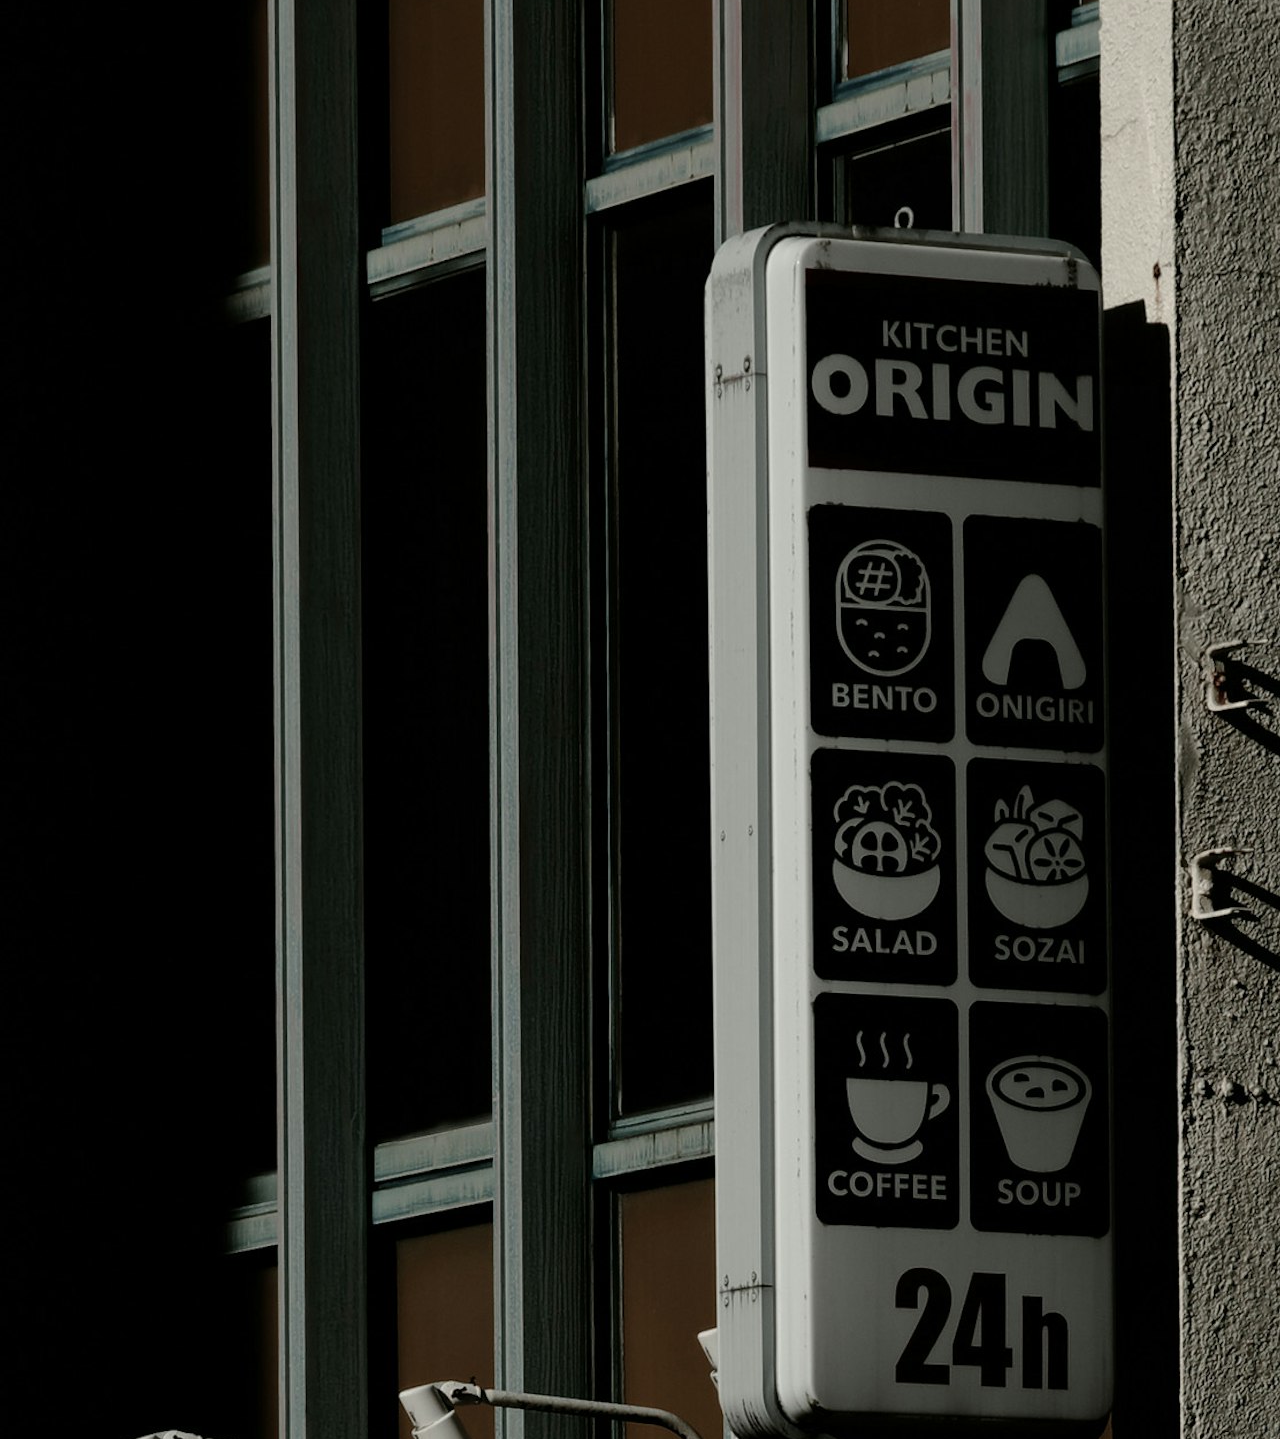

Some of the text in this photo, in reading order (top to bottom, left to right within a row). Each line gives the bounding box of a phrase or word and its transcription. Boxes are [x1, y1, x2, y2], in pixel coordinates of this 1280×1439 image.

[882, 319, 1029, 358] KITCHEN
[811, 352, 1094, 432] ORIGIN
[831, 683, 938, 714] BENTO
[975, 692, 1095, 725] ONIGIRI
[831, 925, 938, 957] SALAD
[994, 933, 1086, 966] SOZAI
[827, 1169, 948, 1202] COFFEE
[997, 1178, 1082, 1208] SOUP
[895, 1267, 1069, 1391] 24h
